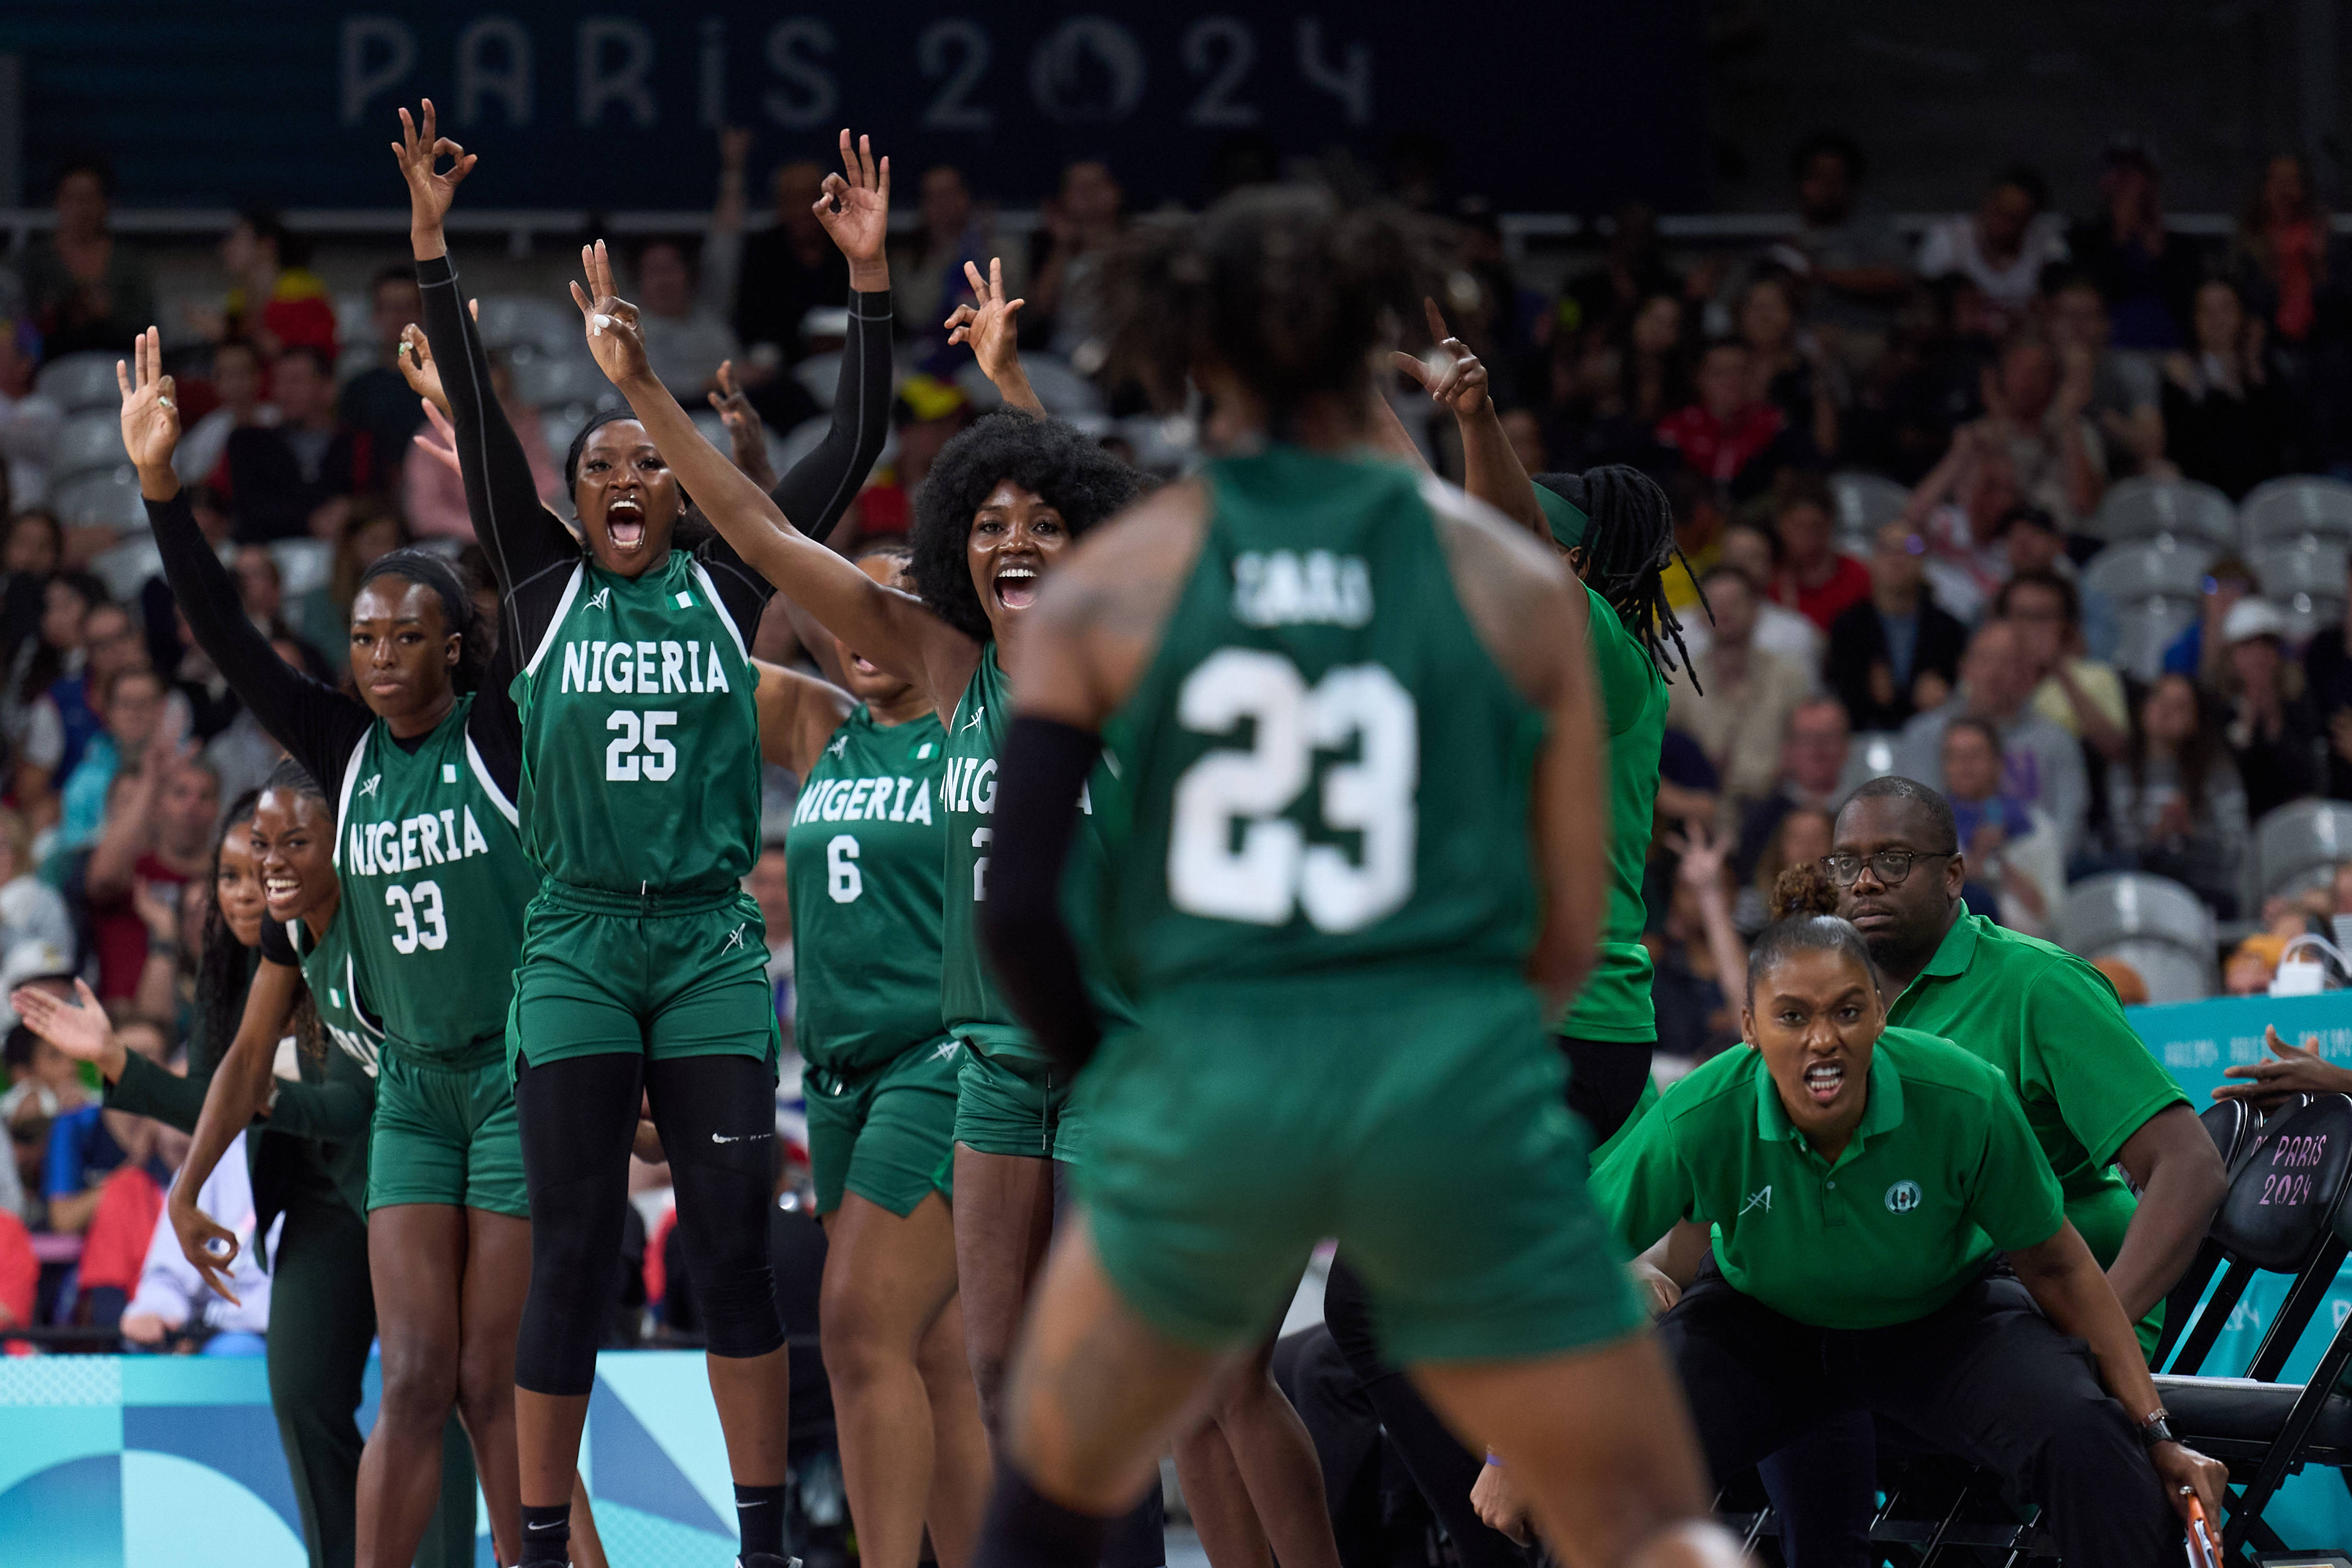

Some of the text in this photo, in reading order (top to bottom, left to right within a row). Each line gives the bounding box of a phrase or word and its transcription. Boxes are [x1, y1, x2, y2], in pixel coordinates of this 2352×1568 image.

[916, 15, 1376, 130] 2024
[561, 640, 729, 694] NIGERIA
[606, 710, 678, 781] 25
[792, 777, 932, 827] NIGERIA
[1169, 647, 1419, 932] 23
[349, 804, 488, 876] NIGERIA
[827, 835, 862, 903] 6
[385, 880, 448, 954] 33
[2259, 1174, 2312, 1205] 2024
